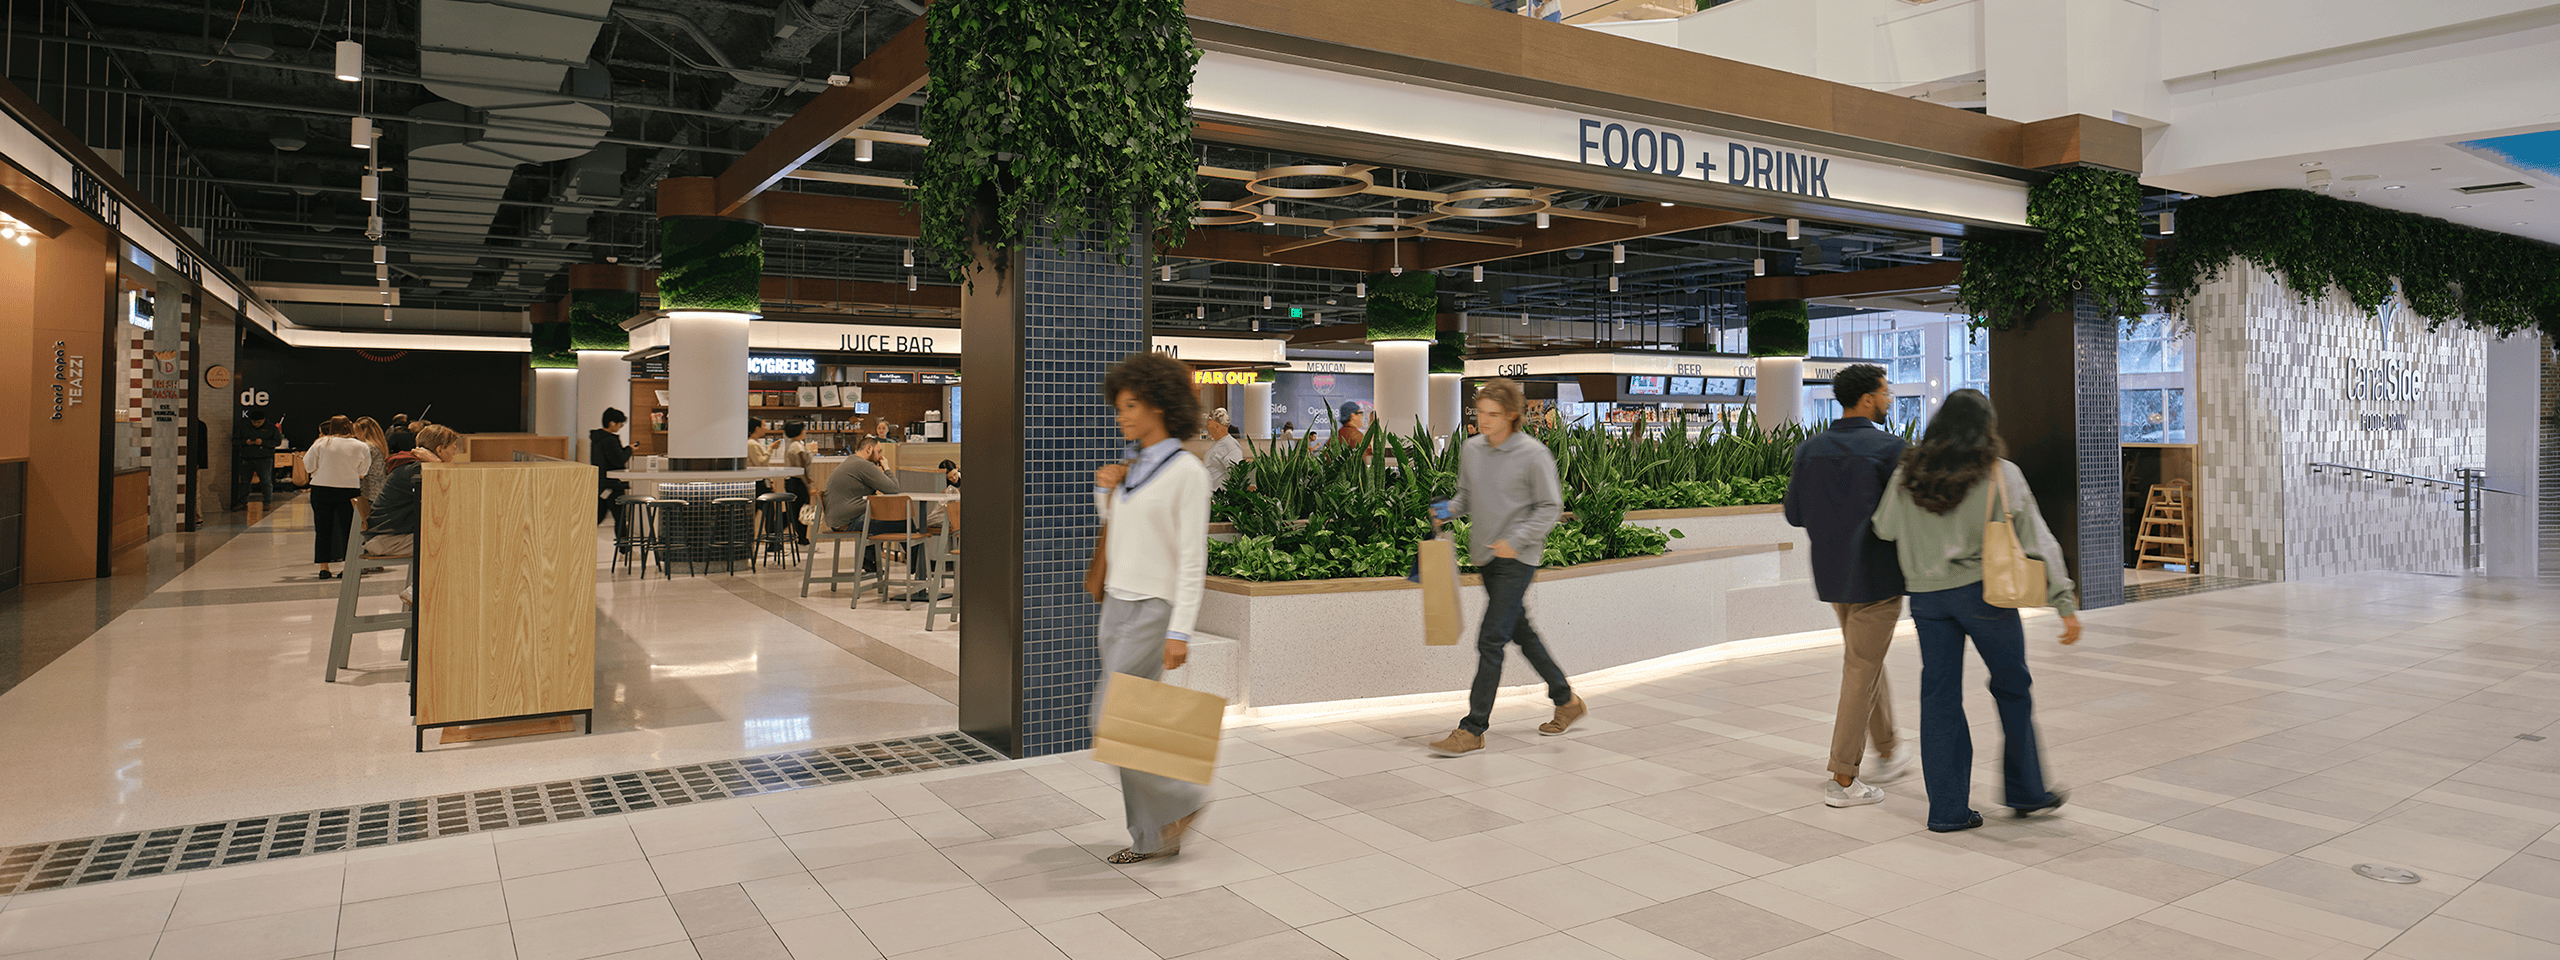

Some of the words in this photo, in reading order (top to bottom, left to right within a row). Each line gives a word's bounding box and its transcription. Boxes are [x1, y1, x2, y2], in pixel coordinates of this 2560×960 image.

[1579, 118, 1685, 177] FOOD
[1696, 152, 1716, 182] +
[1728, 142, 1829, 198] DRINK
[840, 334, 890, 351] JUICE
[897, 336, 934, 353] BAR
[1151, 344, 1178, 359] AM
[52, 340, 67, 380] papa's
[165, 362, 174, 373] D
[1307, 362, 1346, 373] MEXICAN
[1498, 363, 1528, 377] C-SIDE
[1677, 363, 1701, 375] BEER
[69, 355, 84, 406] TEAZZI
[152, 379, 179, 389] FRESH
[1194, 371, 1225, 384] FAR
[1226, 371, 1258, 385] OUT
[2346, 356, 2421, 401] CanalSide
[152, 389, 179, 399] PASTA
[50, 384, 64, 420] beard
[2361, 413, 2382, 431] FOOD
